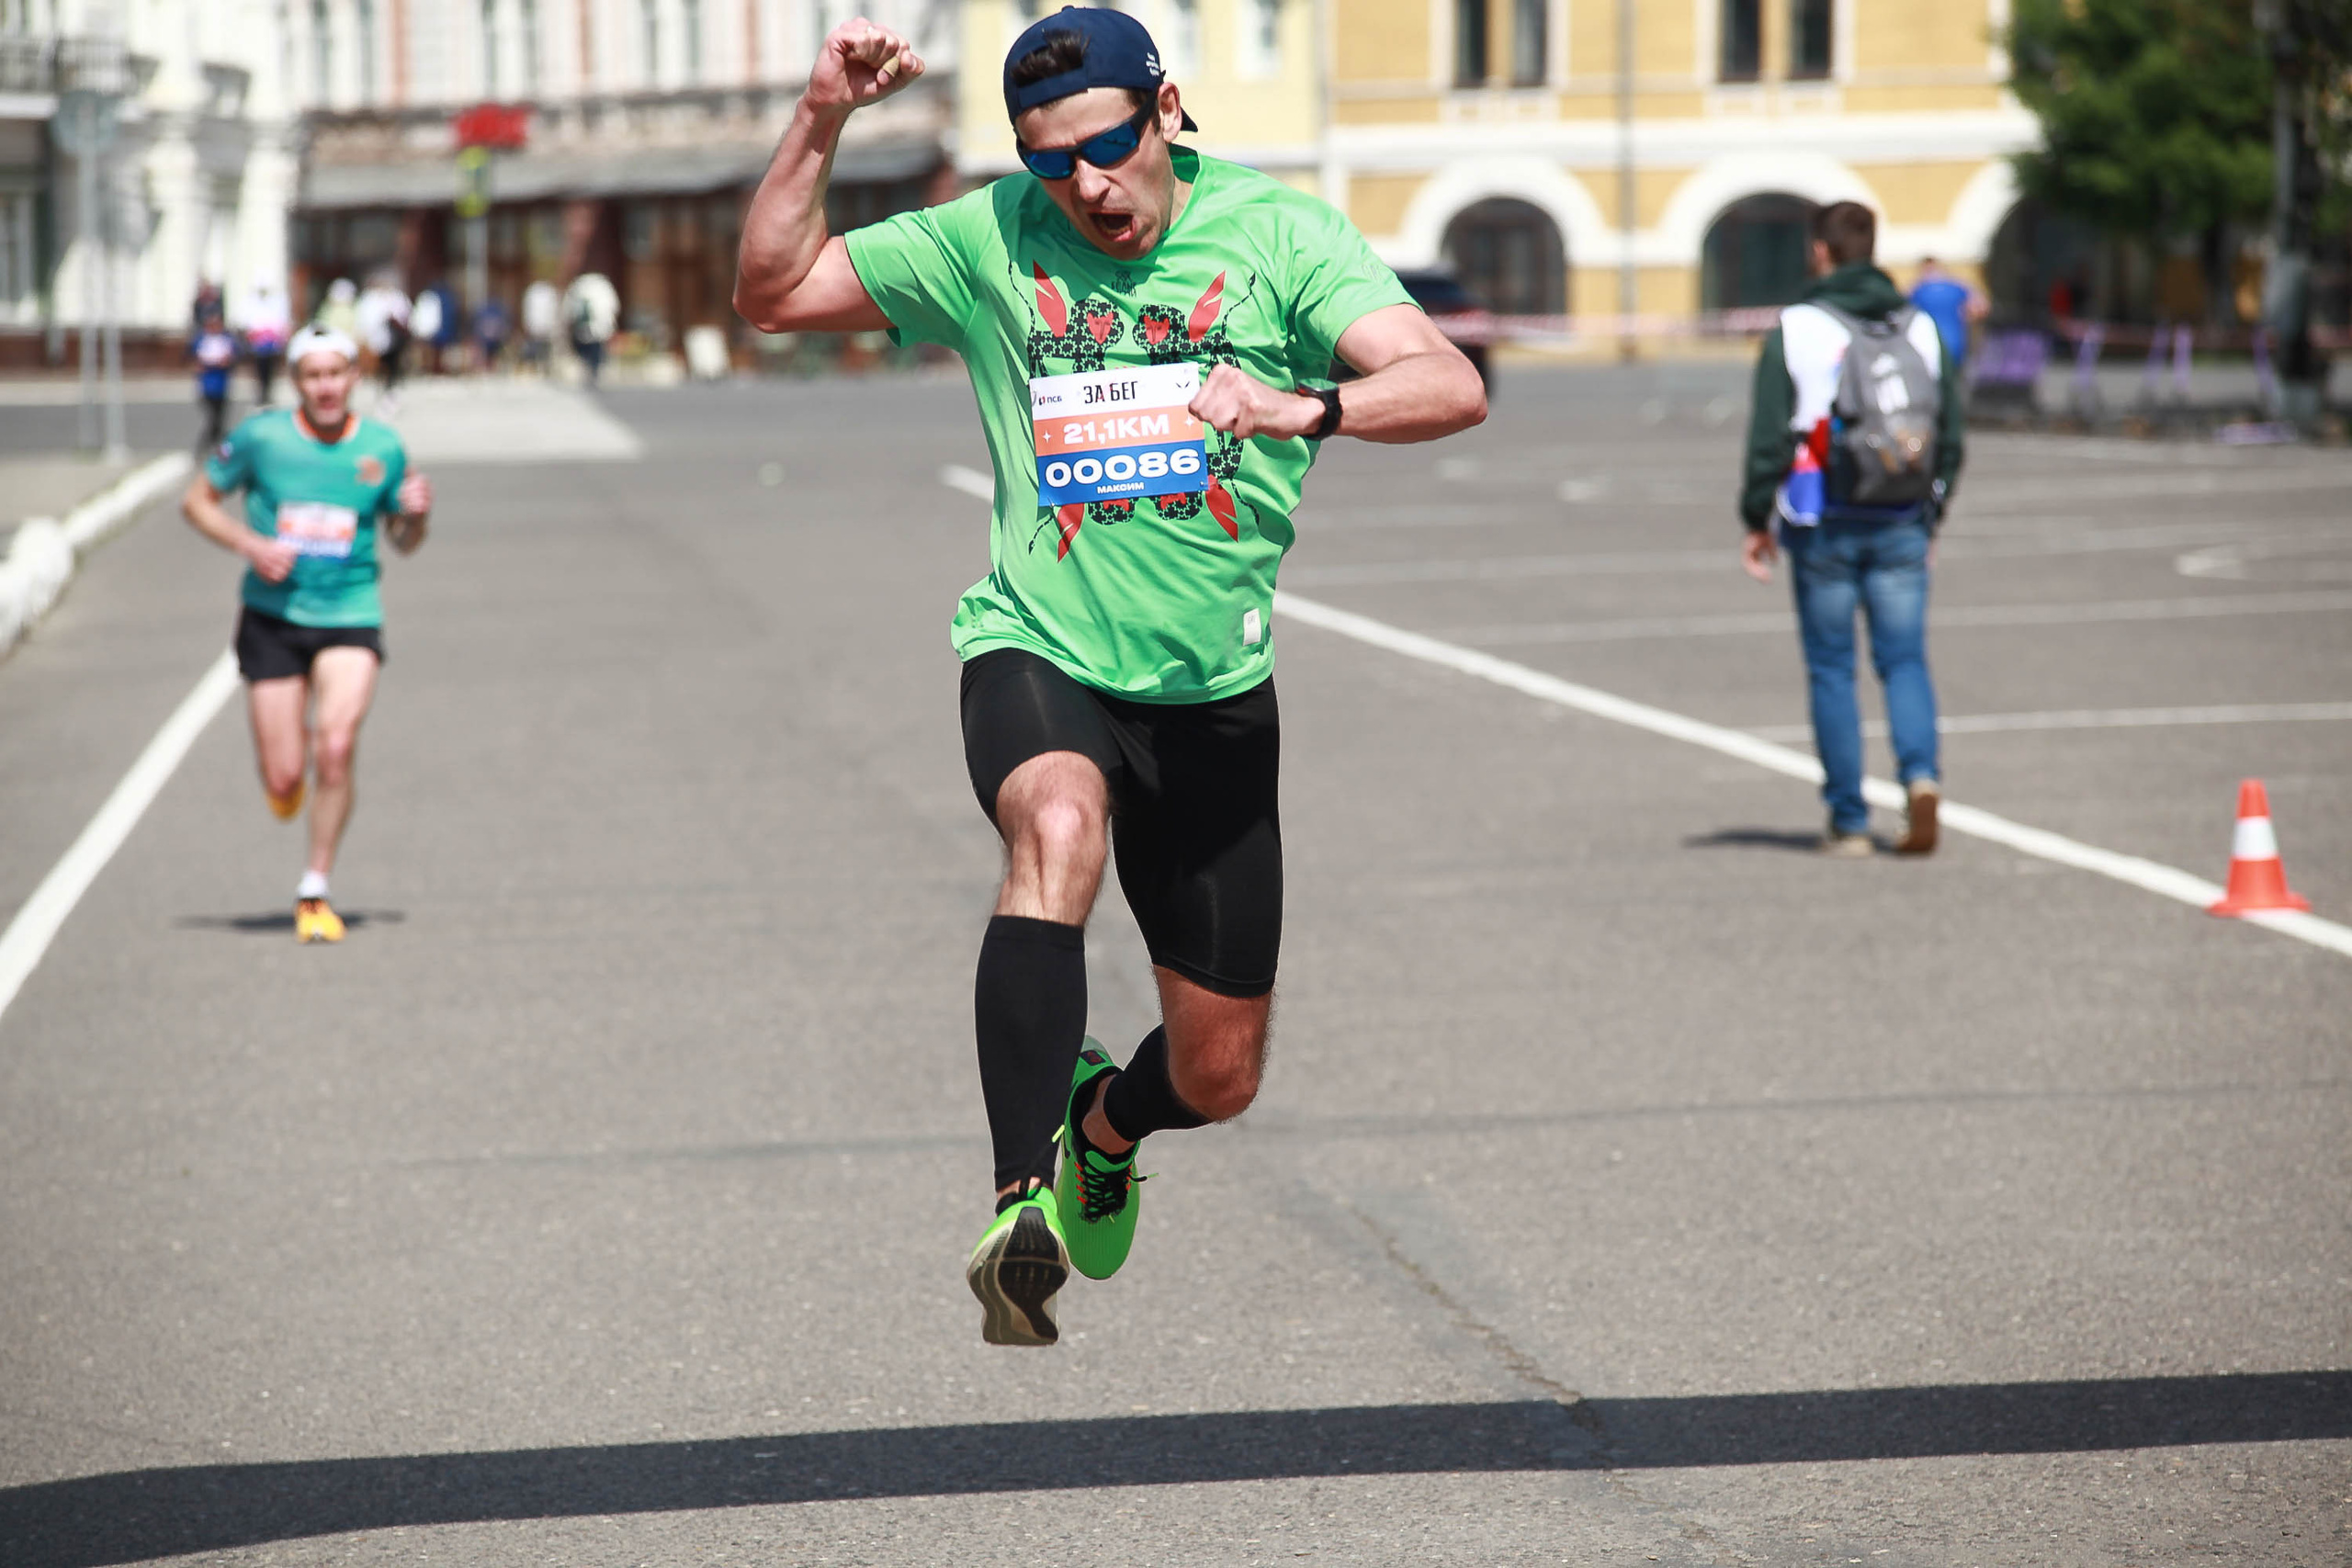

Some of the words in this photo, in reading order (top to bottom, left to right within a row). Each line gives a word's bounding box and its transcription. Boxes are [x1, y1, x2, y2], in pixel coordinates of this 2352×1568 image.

[1063, 413, 1170, 445] 21,1КМ
[1045, 448, 1201, 488] 00086
[1096, 481, 1145, 494] МАКСИМ
